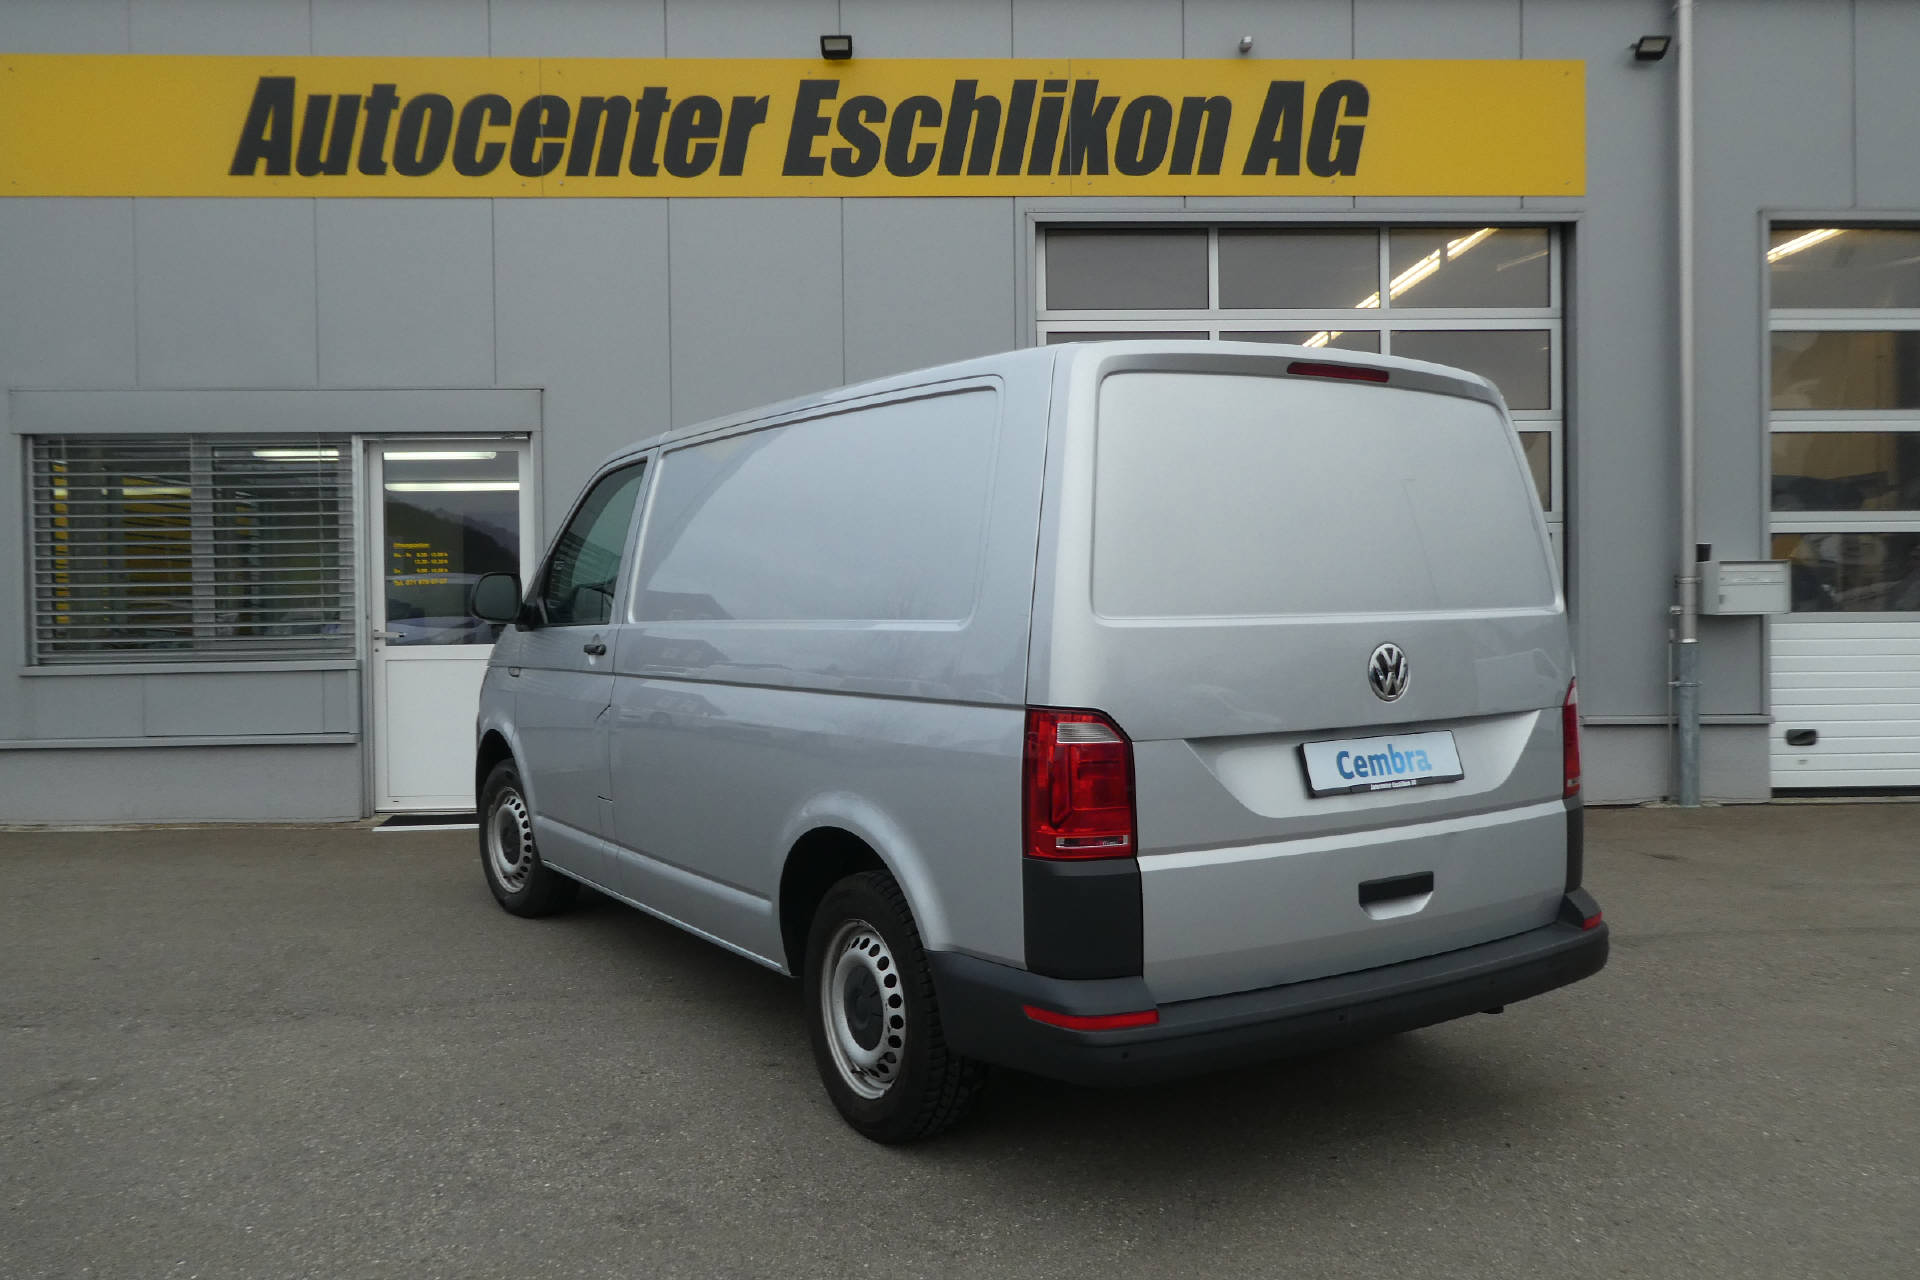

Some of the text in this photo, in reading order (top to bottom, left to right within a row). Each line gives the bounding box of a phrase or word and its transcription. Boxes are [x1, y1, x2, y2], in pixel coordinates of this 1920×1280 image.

[228, 76, 1370, 179] Autocenter Eschlikon AG
[1336, 743, 1433, 780] Cembra
